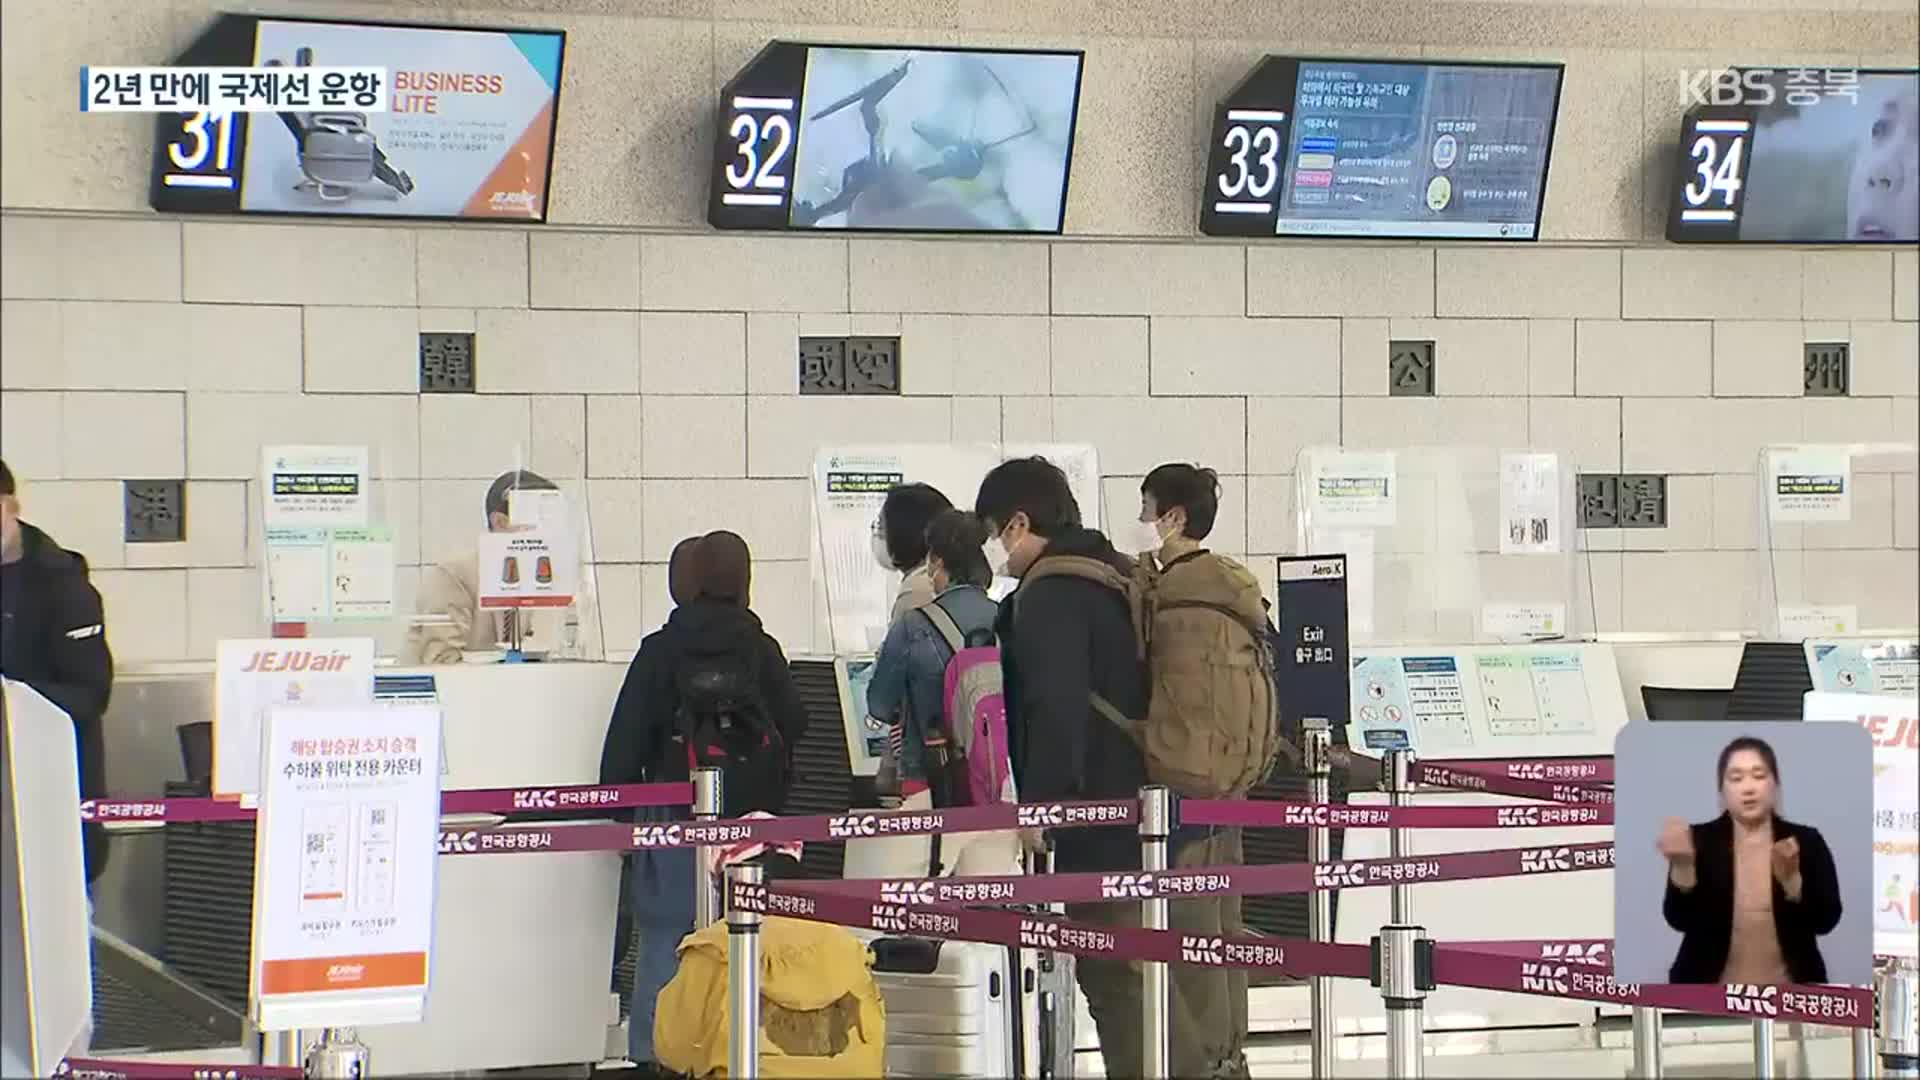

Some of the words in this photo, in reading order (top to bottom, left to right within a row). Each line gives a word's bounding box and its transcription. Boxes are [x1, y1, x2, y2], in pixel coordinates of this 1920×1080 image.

[394, 71, 503, 94] BUSINESS
[392, 95, 438, 114] LITE
[167, 112, 237, 169] 31
[725, 115, 792, 189] 32
[1219, 126, 1281, 198] 33
[1685, 136, 1744, 206] 34
[1303, 626, 1324, 643] Exit
[241, 648, 351, 672] JEJUair
[291, 740, 319, 757] 해당
[321, 738, 360, 756] 탑승권
[363, 737, 388, 753] 소지
[391, 736, 416, 753] 승객
[283, 760, 322, 779] 수하물
[326, 758, 351, 778] 위탁
[355, 757, 379, 777] 전용
[383, 756, 421, 776] 카운터
[1508, 763, 1545, 780] KAC
[514, 790, 557, 808] KAC
[559, 790, 619, 804] 한국공항공사
[1018, 804, 1064, 827] KAC
[1065, 806, 1129, 821] 한국공항공사
[1285, 804, 1327, 825] KAC
[1330, 807, 1389, 823] 한국공항공사
[1498, 807, 1538, 826] KAC
[1541, 808, 1599, 822] 한국공항공사
[632, 825, 681, 847] KAC
[684, 825, 752, 842] 한국공항공사
[829, 815, 876, 838] KAC
[879, 815, 945, 833] 한국공항공사
[481, 832, 552, 849] 한국공항공사
[1521, 849, 1571, 872] KAC
[1102, 874, 1154, 898] KAC
[1157, 874, 1231, 892] 한국공항공사
[1314, 862, 1365, 888] KAC
[1368, 861, 1440, 880] 한국공항공사
[734, 885, 767, 911] KAC
[881, 880, 935, 905] KAC
[939, 882, 1015, 901] 한국공항공사
[872, 904, 909, 931] KAC
[908, 911, 959, 933] 한국공항공사
[1020, 918, 1058, 948] KAC
[1060, 926, 1115, 951] 한국공항공사
[1182, 936, 1223, 965] KAC
[1225, 943, 1284, 966] 한국공항공사
[1522, 962, 1569, 994] KAC
[1725, 983, 1778, 1016] KAC
[1782, 991, 1859, 1018] 한국공항공사
